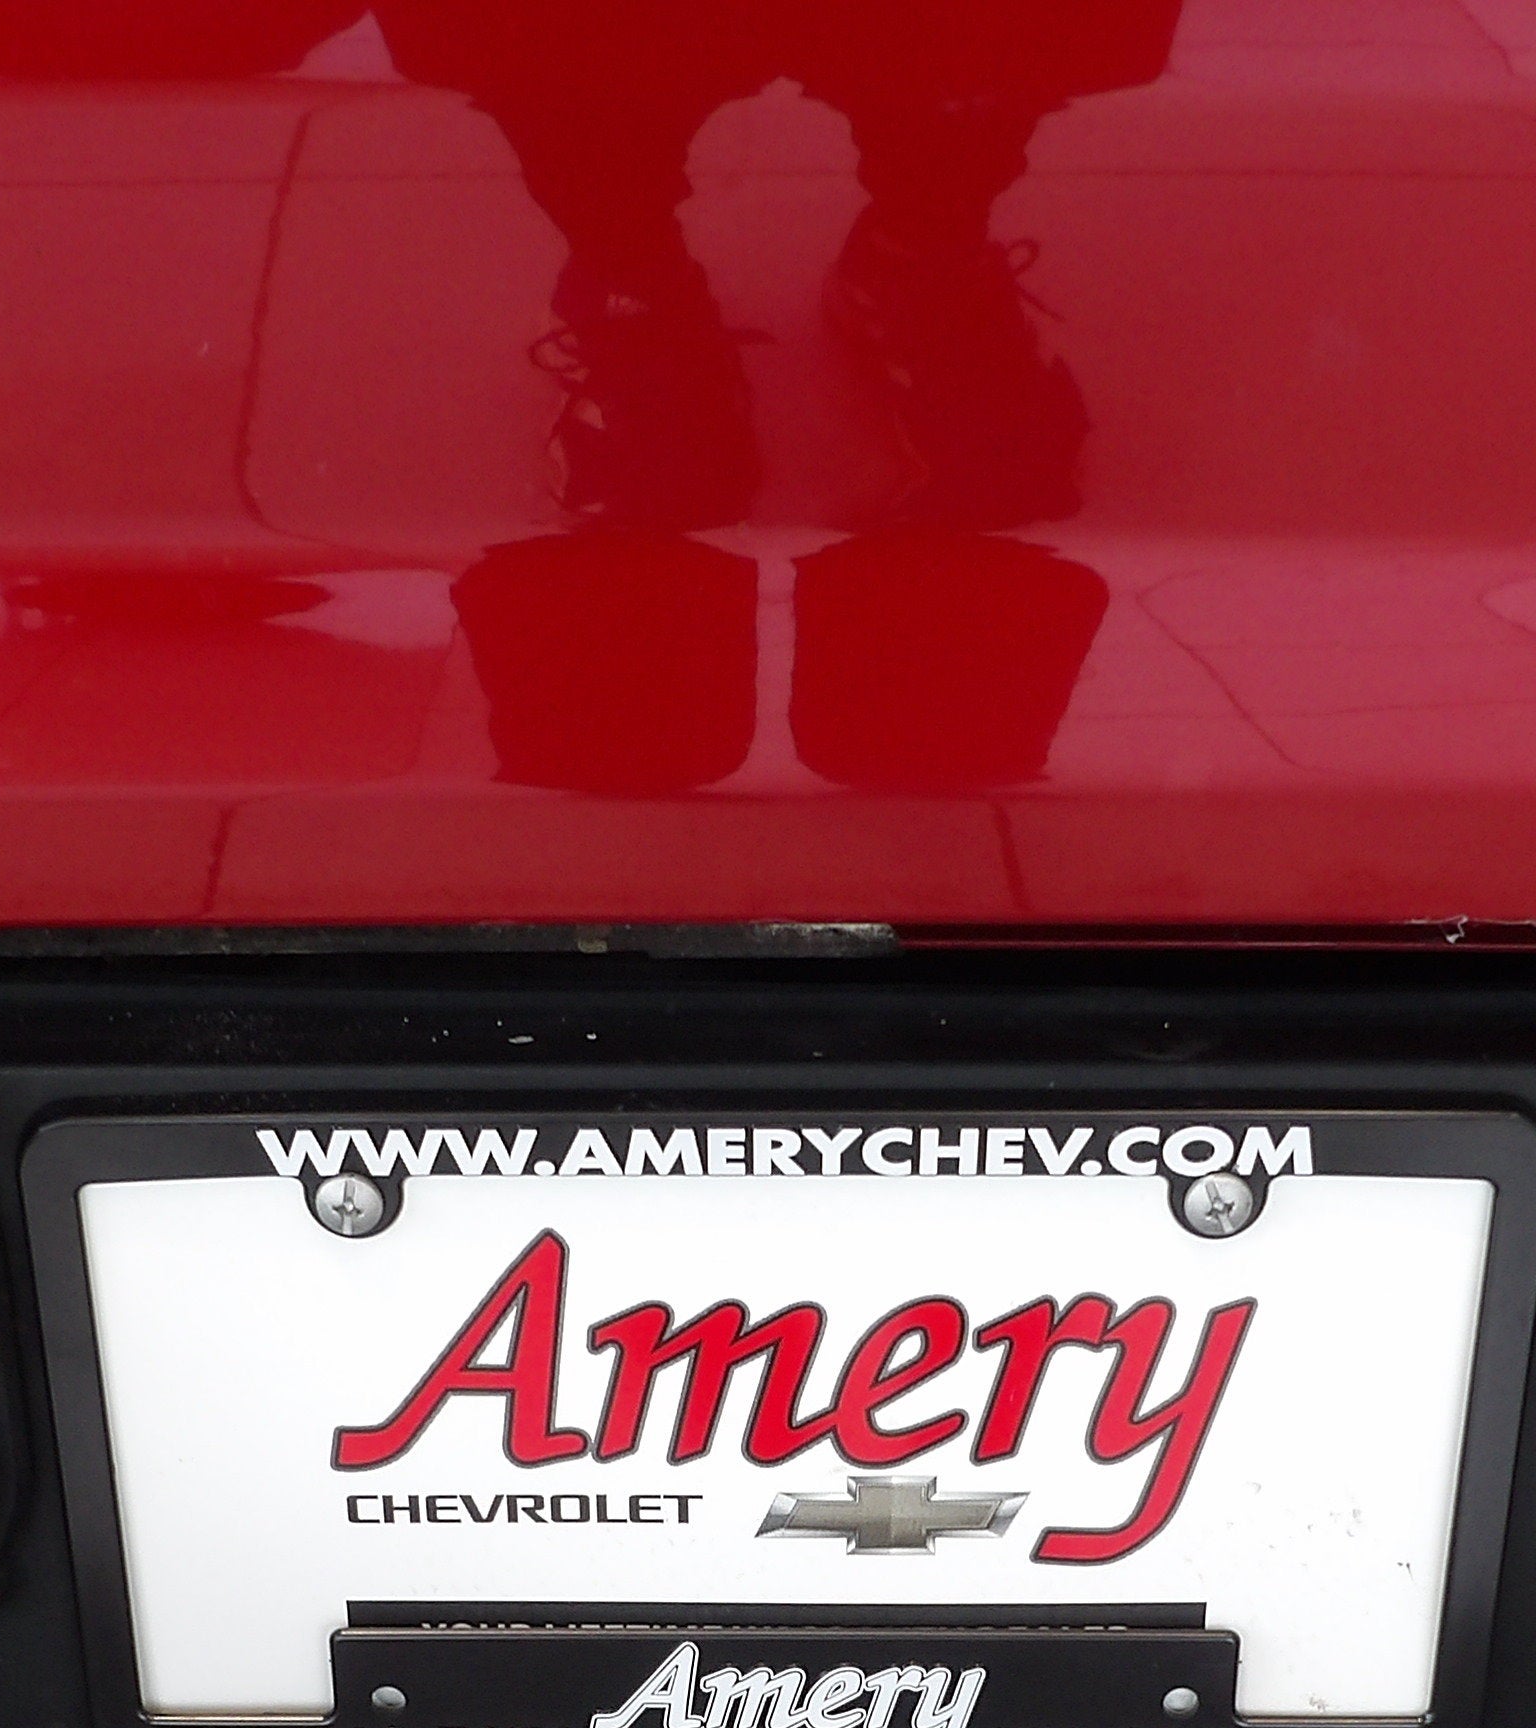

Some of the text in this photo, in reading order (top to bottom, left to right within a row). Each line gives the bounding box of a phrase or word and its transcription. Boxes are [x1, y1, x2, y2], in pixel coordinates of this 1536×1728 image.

[257, 1125, 1314, 1177] WWW.AMERYCHEV.COM
[331, 1229, 1257, 1566] Amery
[346, 1494, 704, 1524] CHEVROLET
